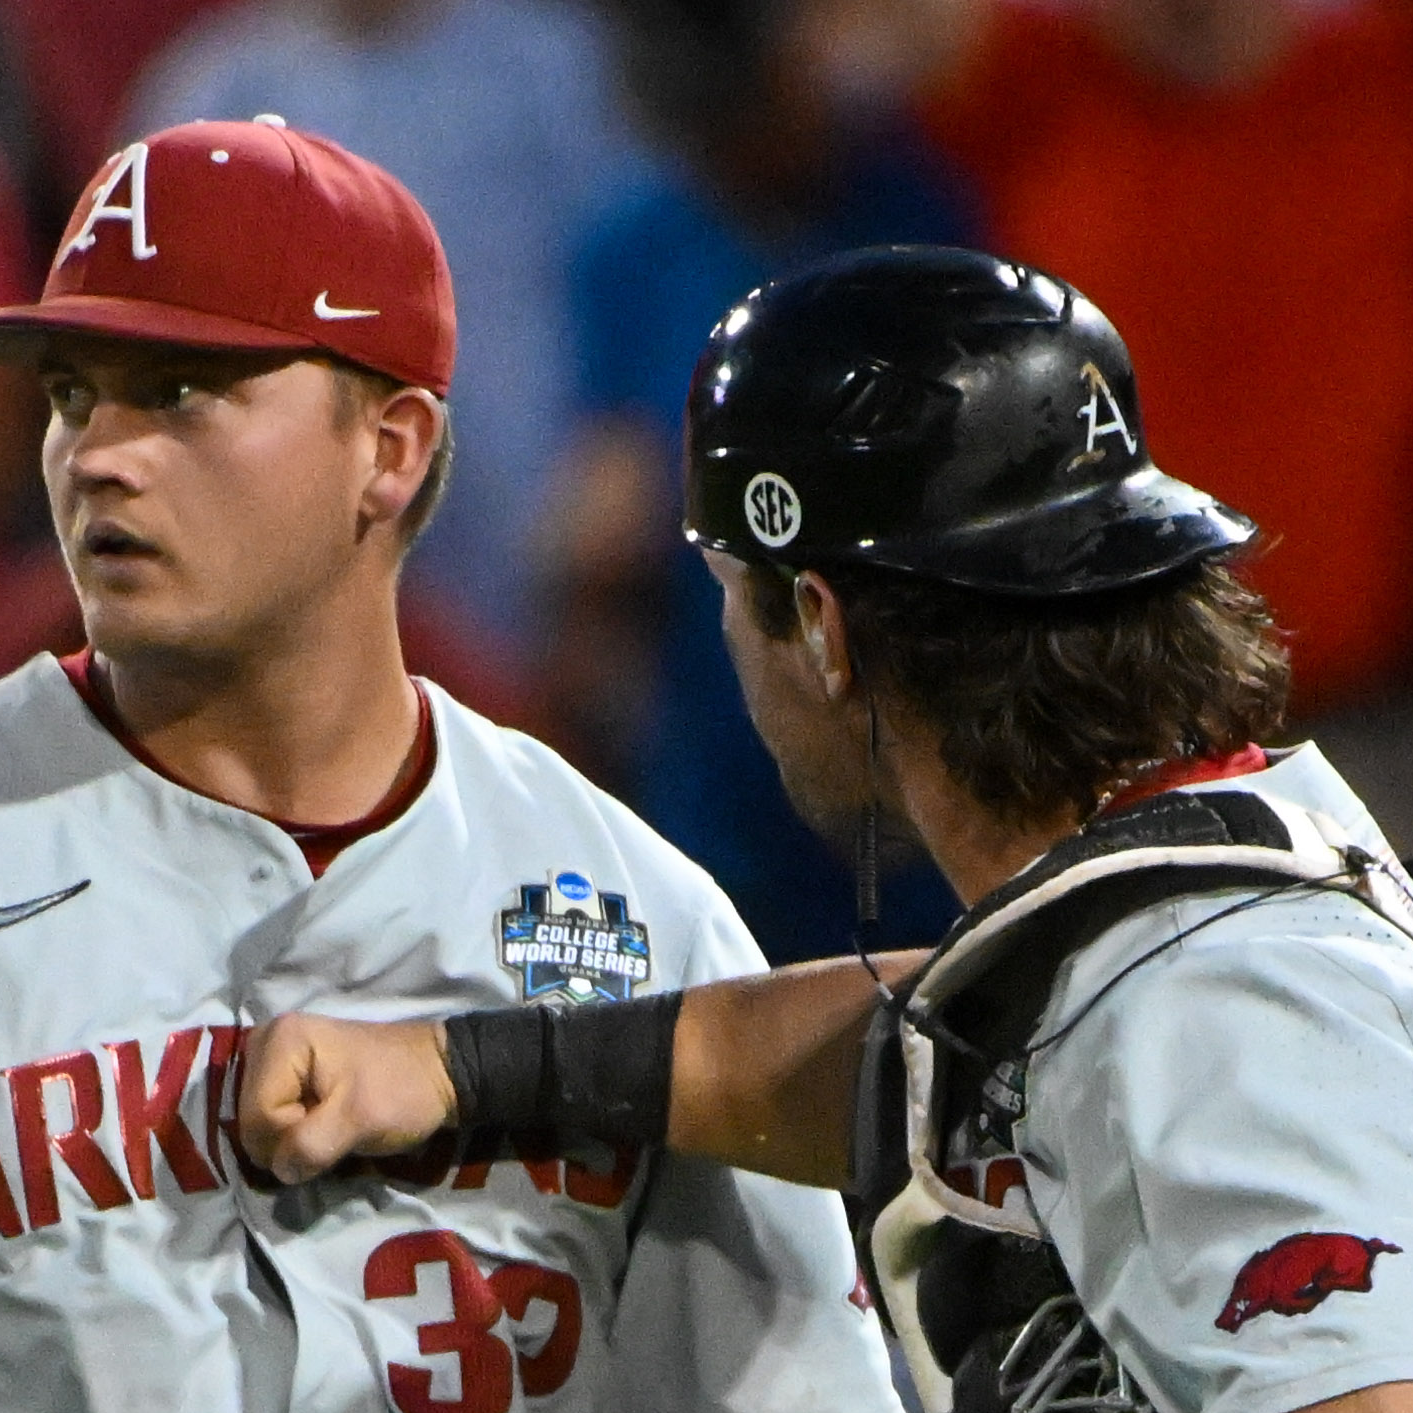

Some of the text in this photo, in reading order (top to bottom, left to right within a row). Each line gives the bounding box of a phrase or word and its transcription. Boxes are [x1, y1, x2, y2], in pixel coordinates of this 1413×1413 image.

[56, 142, 158, 270] A
[1066, 361, 1138, 473] A
[749, 479, 795, 538] SEC
[505, 942, 649, 980] WORLD SERIES
[536, 924, 620, 952] COLLEGE
